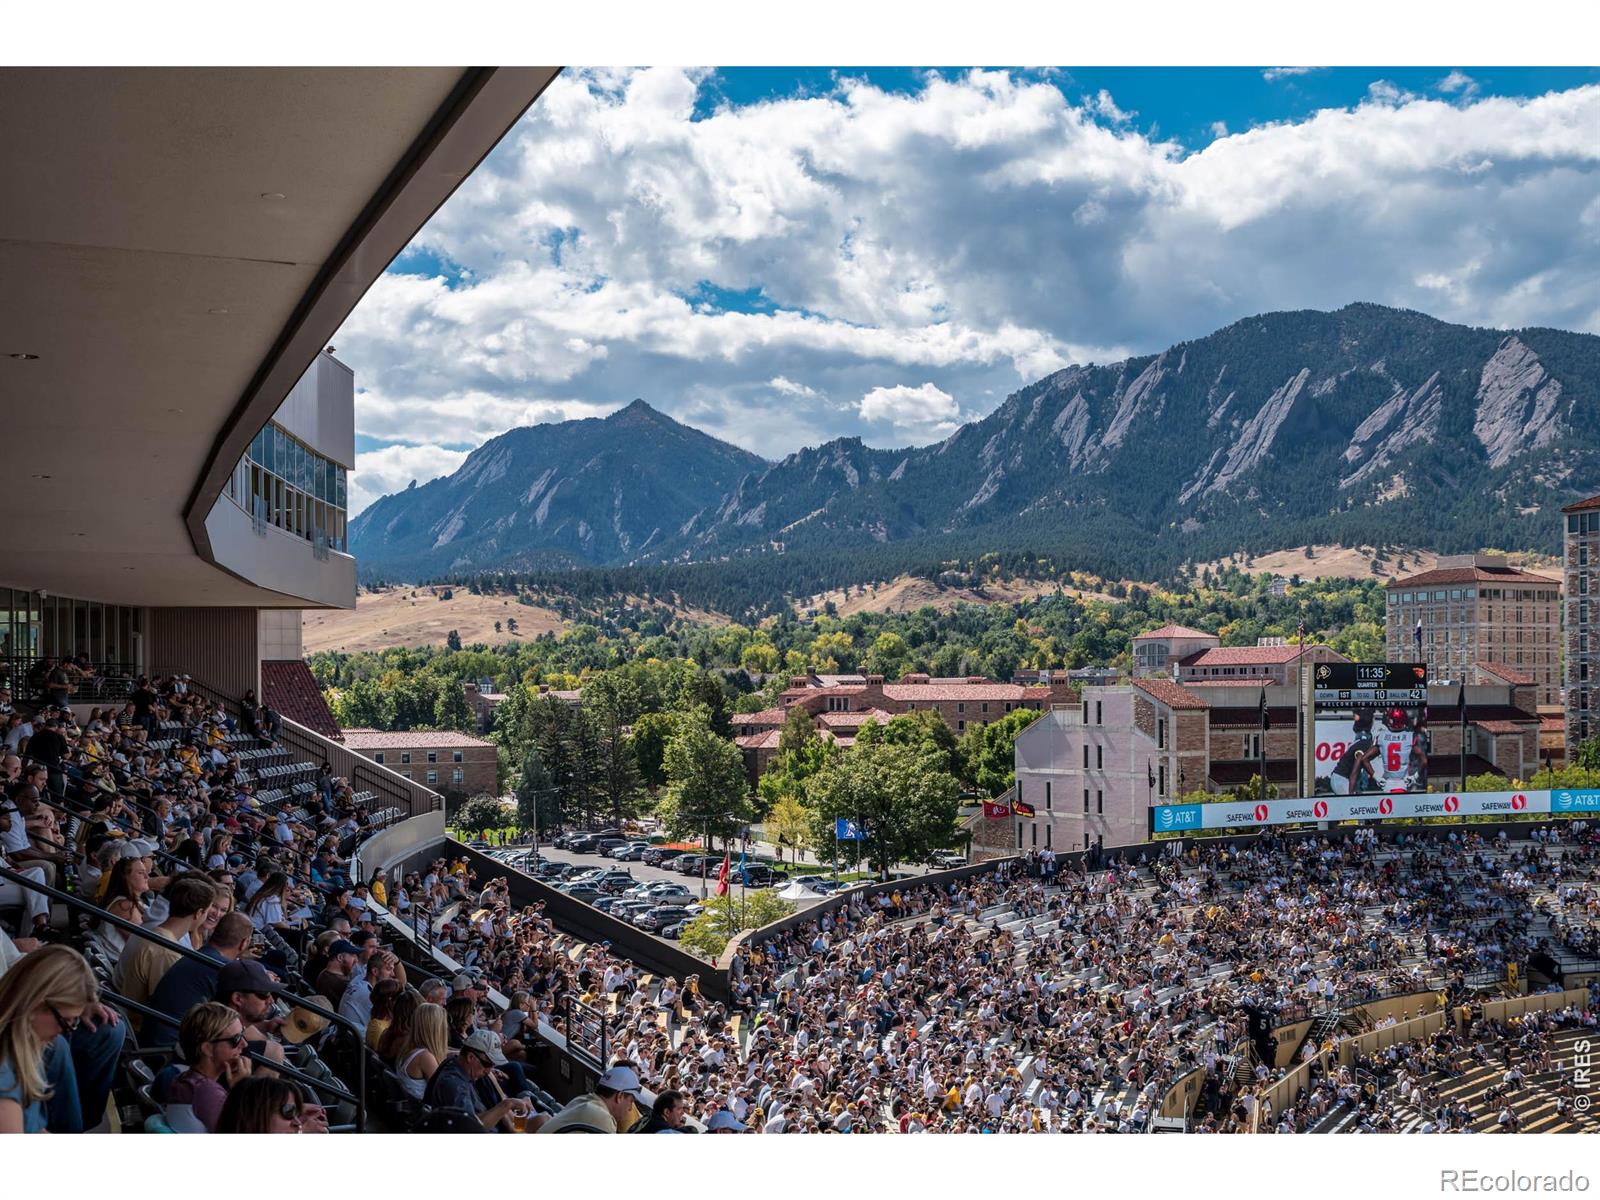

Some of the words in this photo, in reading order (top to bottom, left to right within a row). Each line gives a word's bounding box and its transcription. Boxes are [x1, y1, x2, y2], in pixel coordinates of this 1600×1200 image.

[1360, 667, 1384, 678] 11:35
[1376, 690, 1385, 699] 10
[1410, 690, 1420, 699] 42
[1388, 743, 1401, 771] 6
[1574, 794, 1600, 806] AT&T
[1349, 806, 1379, 816] SAFEWAY
[1414, 804, 1444, 813] SAFEWAY
[1481, 802, 1511, 811] SAFEWAY
[1174, 811, 1197, 824] AT&T
[1227, 813, 1255, 822] SAFEWAY
[1286, 809, 1313, 819] SAFEWAY
[1260, 1019, 1267, 1030] 5
